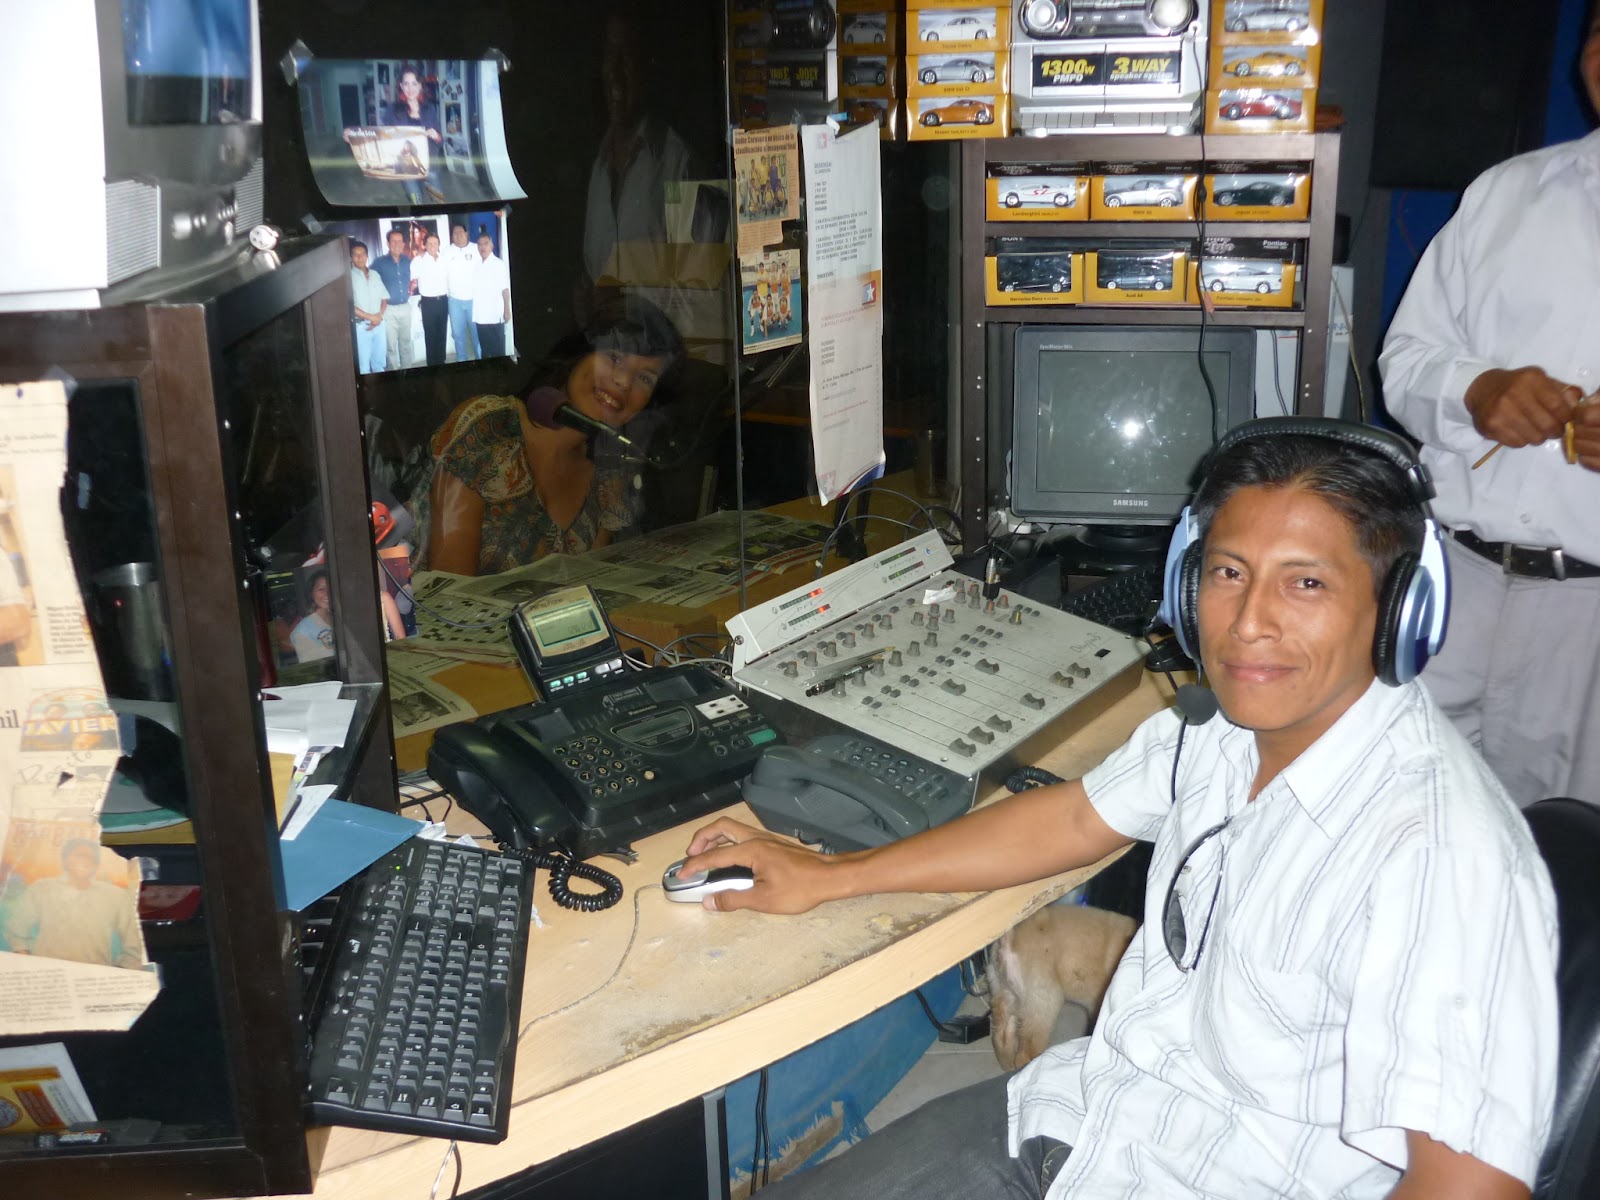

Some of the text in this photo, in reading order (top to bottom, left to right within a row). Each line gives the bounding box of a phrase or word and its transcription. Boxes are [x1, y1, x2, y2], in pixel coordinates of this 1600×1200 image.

[1112, 56, 1172, 74] 3 WAY
[1052, 73, 1084, 84] PMPO
[1110, 72, 1142, 82] speaker
[1112, 499, 1149, 507] SAMSUNG
